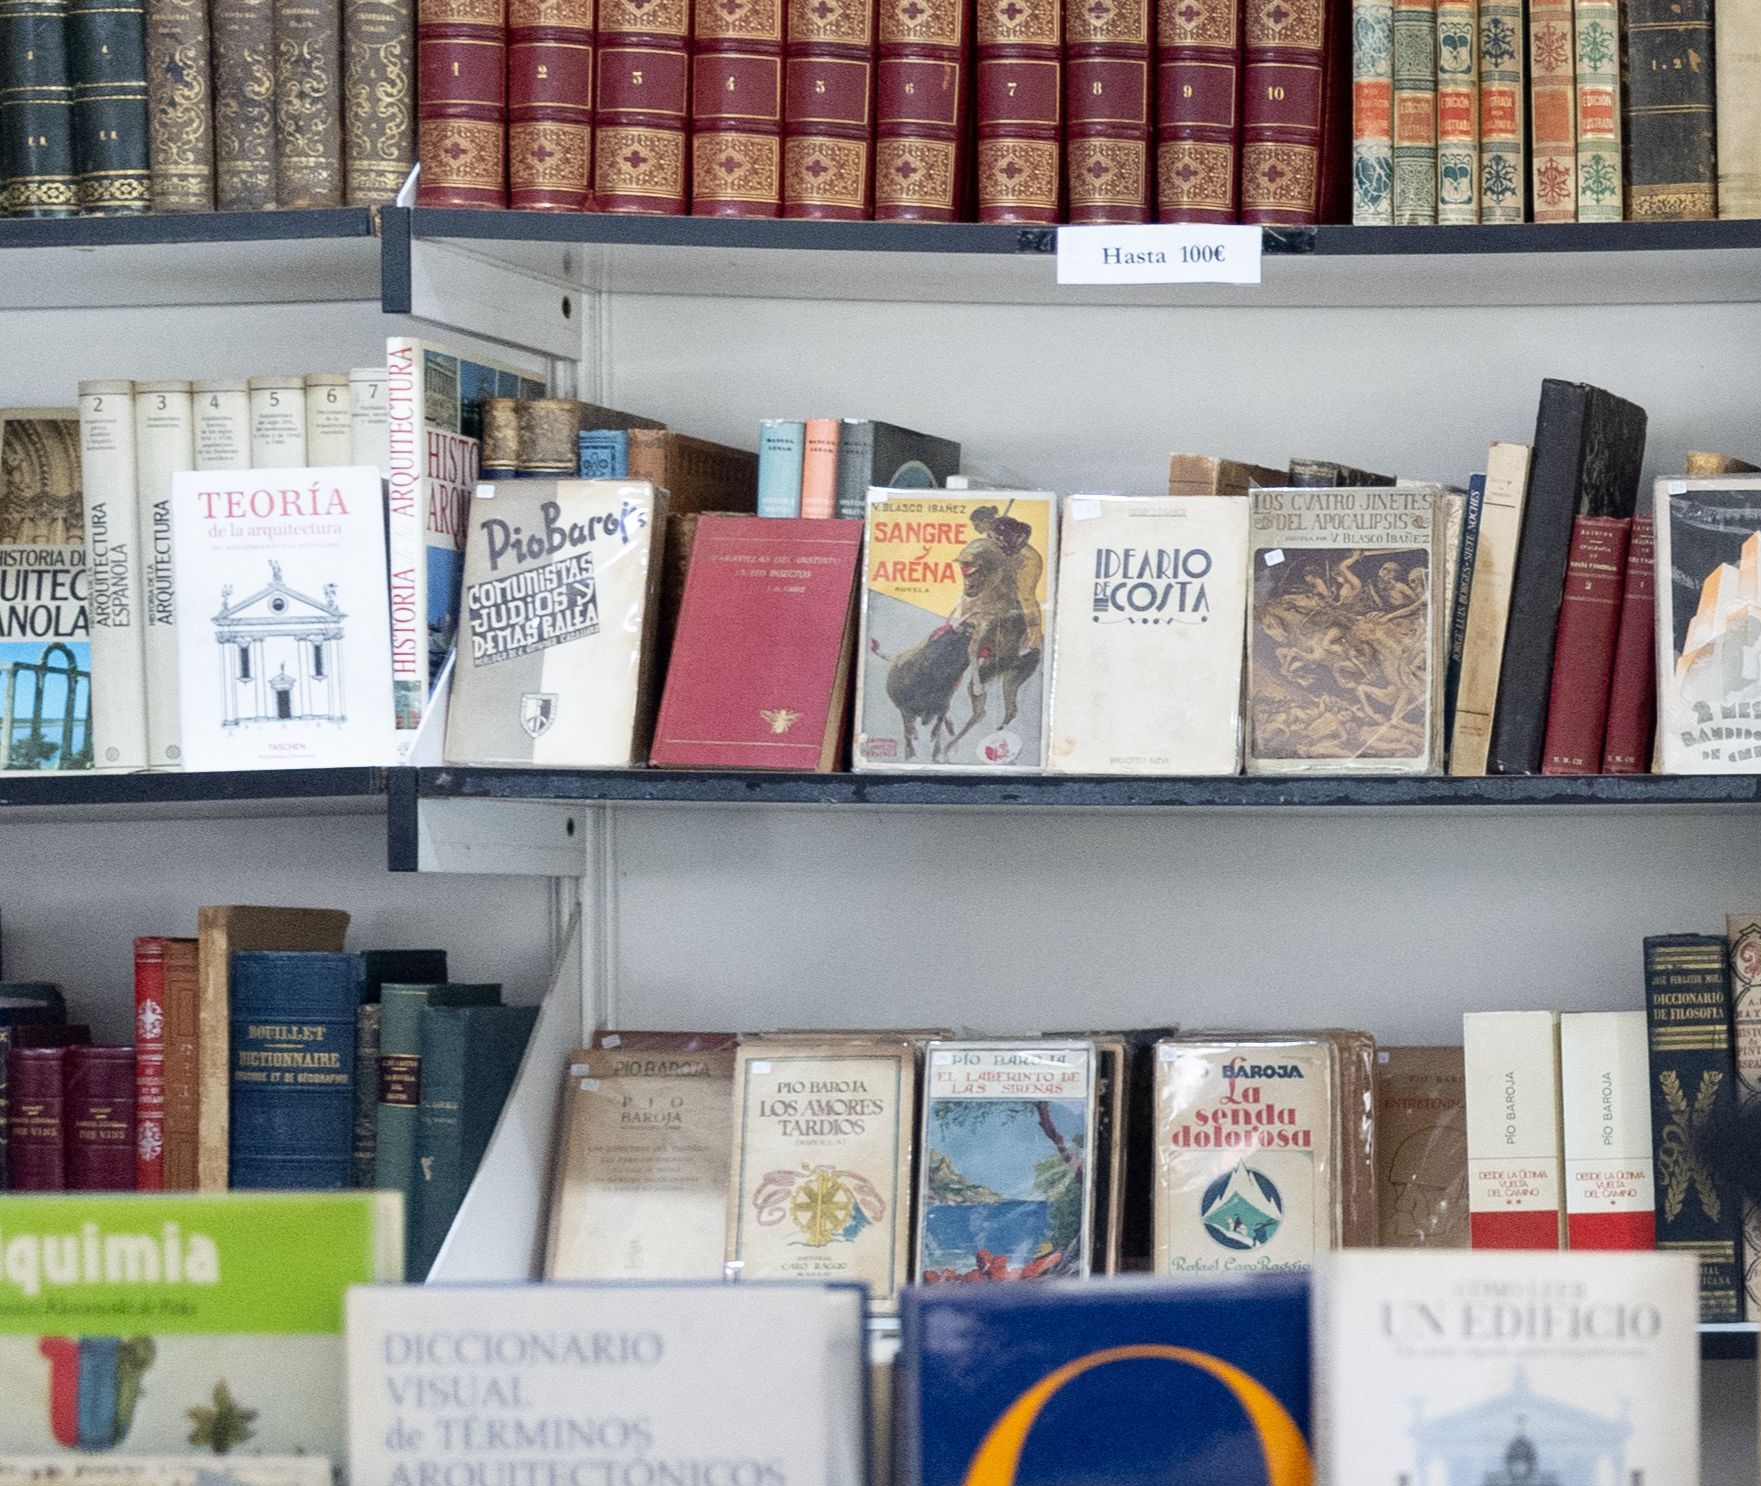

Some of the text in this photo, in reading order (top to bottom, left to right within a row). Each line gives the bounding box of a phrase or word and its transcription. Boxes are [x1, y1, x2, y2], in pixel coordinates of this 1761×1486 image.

[452, 61, 460, 77] 1
[905, 82, 915, 96] 6
[1007, 82, 1017, 97] 7
[1092, 81, 1103, 96] 8
[1183, 84, 1193, 99] 9
[1266, 86, 1284, 101] 10
[1102, 244, 1226, 266] Hasta 100€
[270, 392, 280, 407] 5
[327, 388, 337, 404] 6
[369, 384, 378, 399] 7
[93, 398, 103, 412] 2
[158, 395, 167, 410] 3
[209, 395, 220, 409] 4
[198, 481, 350, 519] TEORÍA
[1254, 494, 1284, 512] LOS
[1361, 493, 1432, 511] JINETES
[389, 347, 419, 674] HISTORIA ARQUITECTURA
[928, 503, 967, 514] IBAÑEZ
[1276, 512, 1408, 531] DEL APOCALIPSIS
[208, 522, 342, 540] de la arquitectura
[874, 522, 968, 544] SANGRE
[92, 502, 111, 627] ARQUITECTURA
[154, 500, 174, 625] ARQUITECTURA
[1095, 549, 1213, 580] IDEARIO
[1456, 489, 1479, 629] LUIS SIETE NOCHES
[769, 569, 811, 578] INSECTOS
[872, 560, 957, 584] ARENA
[1110, 581, 1210, 612] COSTA
[1692, 701, 1713, 724] 2
[1702, 749, 1720, 760] DE
[1654, 992, 1724, 1004] DICCIONARIO
[1654, 1008, 1668, 1019] DE
[248, 1025, 326, 1041] BOUILLET
[239, 1052, 340, 1068] DICTIONNAIRE
[952, 1051, 981, 1066] PÍO
[937, 1071, 1080, 1083] EL LABERINTO DE
[1222, 1064, 1303, 1079] BAROJA
[777, 1080, 867, 1094] PIO BAROJA
[1220, 1057, 1261, 1104] La
[951, 1083, 1064, 1095] LAS SIRENAS
[760, 1099, 883, 1117] LOS AMORES
[1195, 1103, 1296, 1128] senda
[1506, 1071, 1516, 1145] PÍO BAROJA
[1603, 1072, 1614, 1145] PÍO BAROJA
[621, 1111, 682, 1124] BAROJA
[778, 1119, 865, 1137] TARDIOS
[1171, 1123, 1312, 1148] dolorosa
[1479, 1171, 1517, 1180] DESDE LA
[1575, 1172, 1614, 1181] DESDE LA
[1487, 1189, 1540, 1197] DEL CAMINO
[1584, 1189, 1637, 1198] DEL CAMINO
[1172, 1257, 1256, 1271] Rafael Caro
[1379, 1303, 1663, 1340] UN EDIFICIO
[384, 1333, 661, 1366] DICCIONARIO
[387, 1376, 532, 1408] VISUAL
[386, 1417, 652, 1452] de TÉRMINOS
